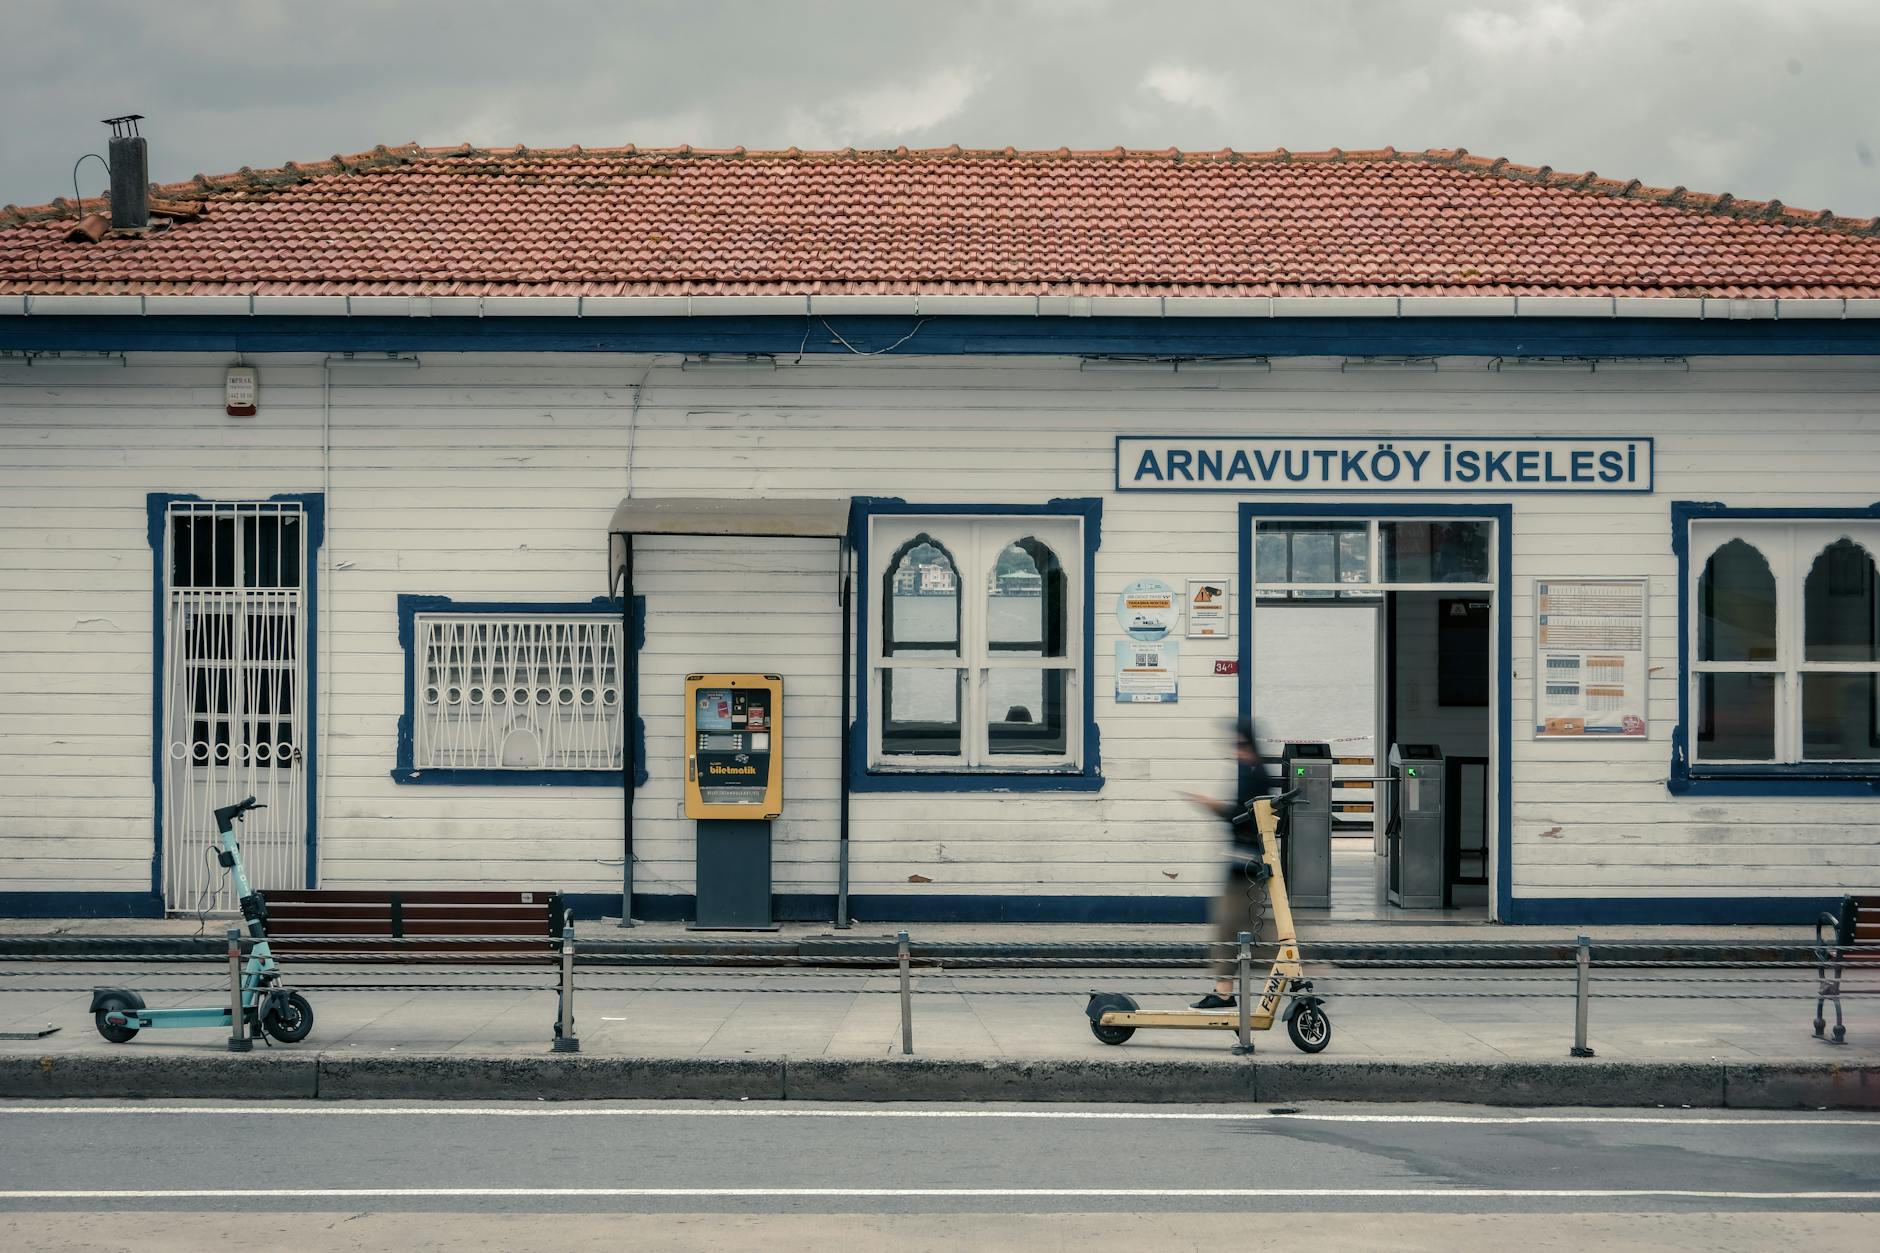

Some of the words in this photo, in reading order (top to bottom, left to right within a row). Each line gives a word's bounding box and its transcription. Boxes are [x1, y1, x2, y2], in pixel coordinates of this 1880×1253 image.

[1134, 444, 1430, 481] ARNAVUTKÖY
[1445, 444, 1635, 482] İSKELESİ
[710, 766, 757, 775] biletmatik
